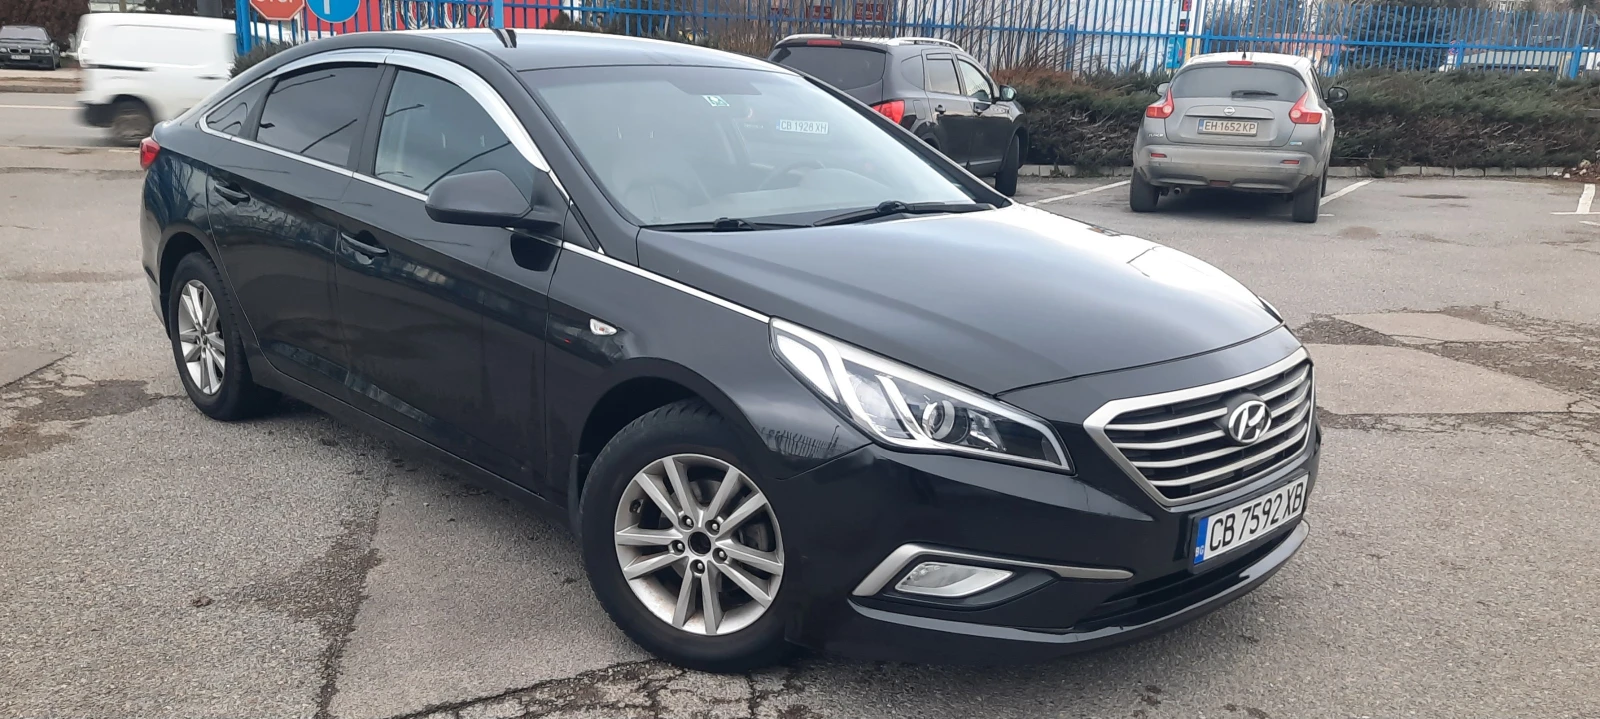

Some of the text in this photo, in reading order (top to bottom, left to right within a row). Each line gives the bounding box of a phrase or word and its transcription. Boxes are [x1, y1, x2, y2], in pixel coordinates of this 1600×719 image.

[781, 121, 827, 132] CB 1928 XH
[1204, 122, 1256, 133] EH 1652 KP
[1209, 482, 1304, 552] CB 7592 XB
[1195, 545, 1205, 557] BG
